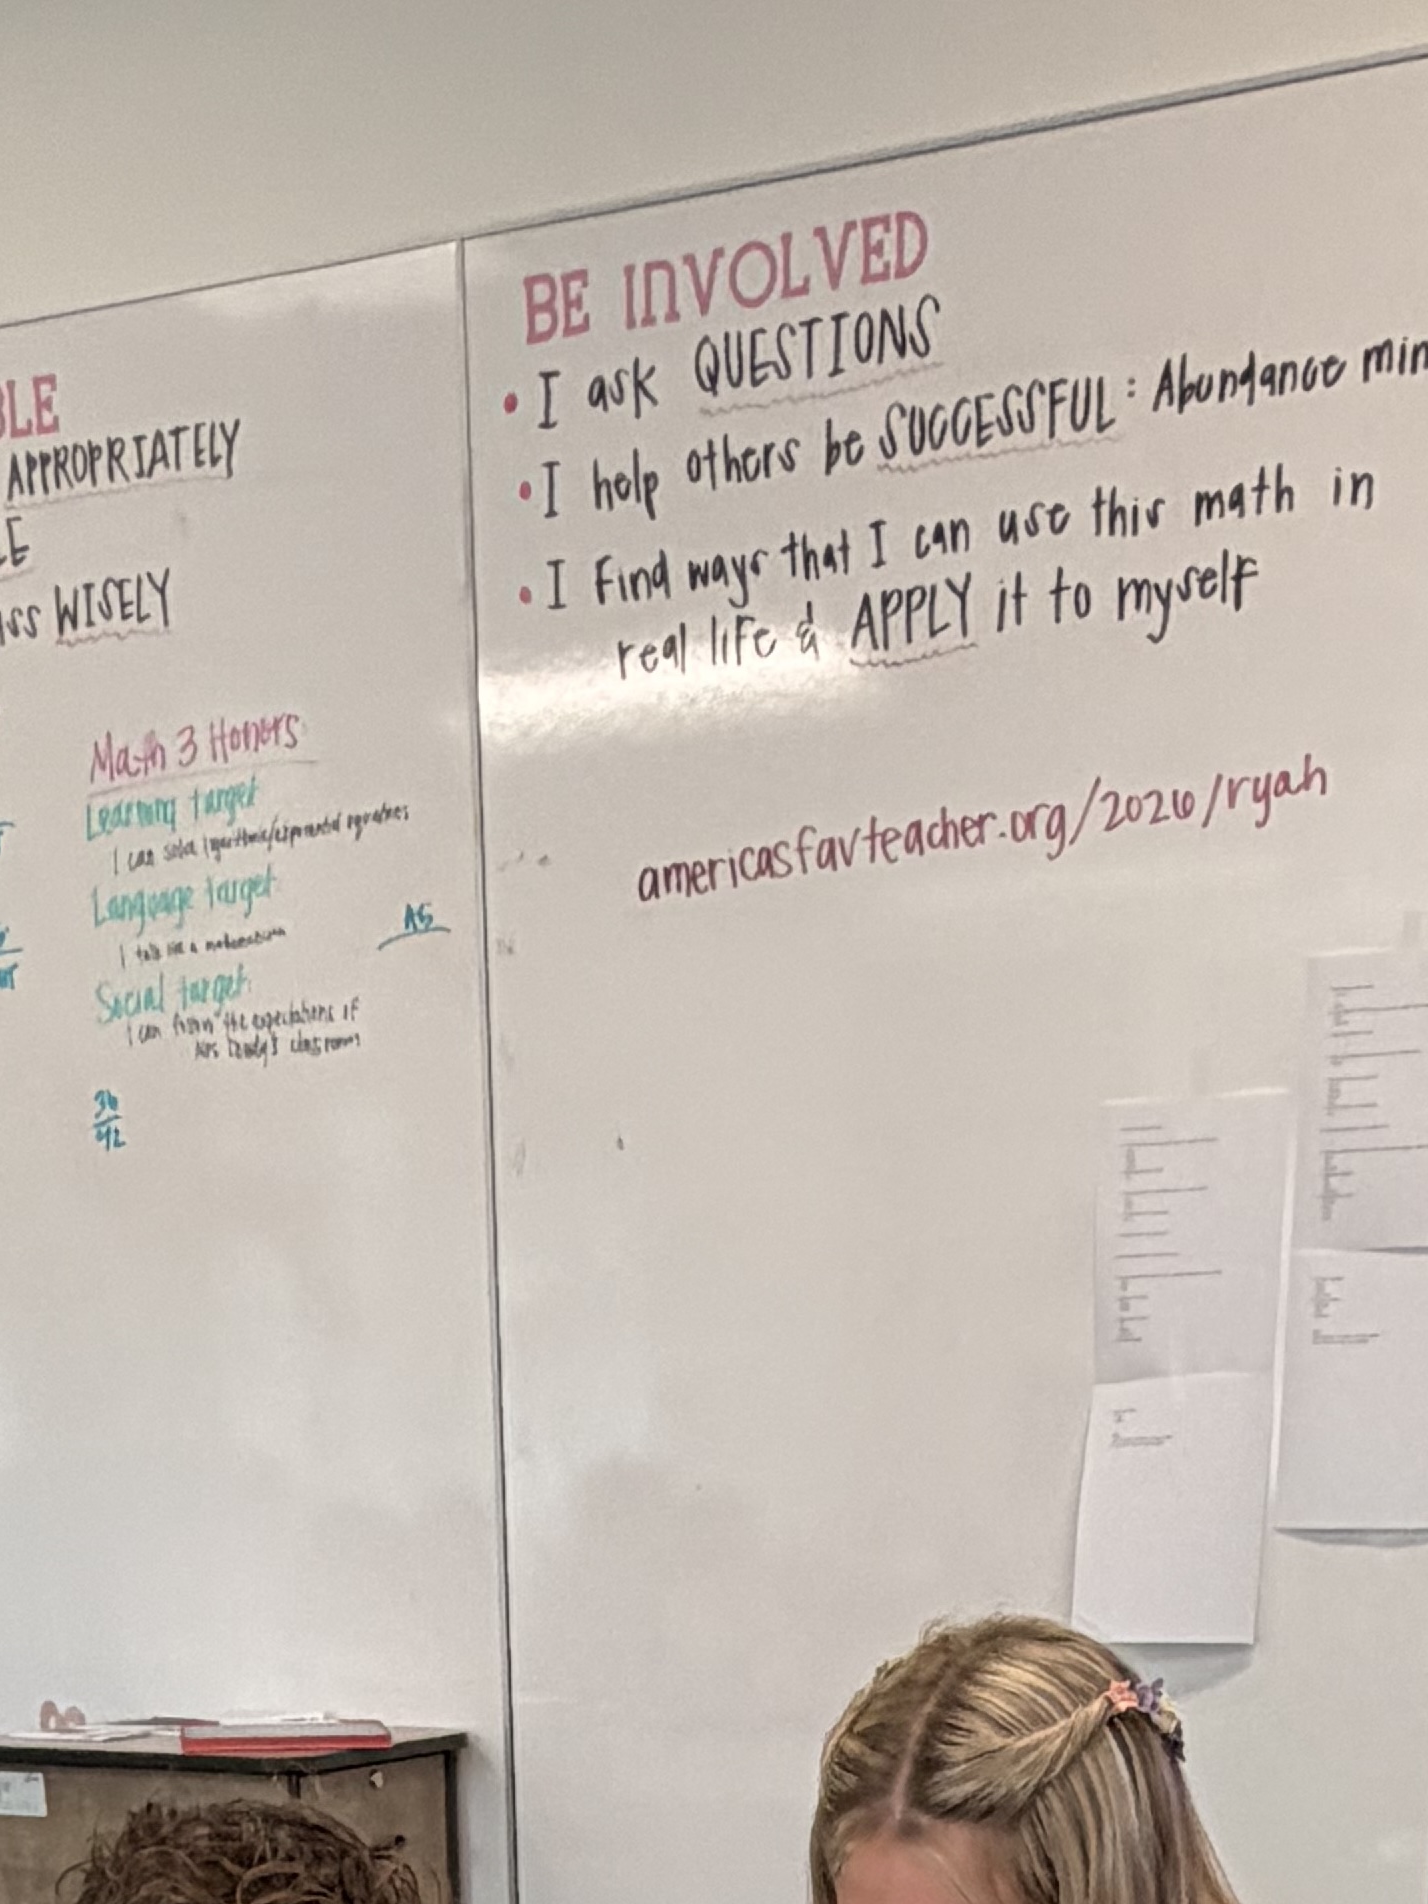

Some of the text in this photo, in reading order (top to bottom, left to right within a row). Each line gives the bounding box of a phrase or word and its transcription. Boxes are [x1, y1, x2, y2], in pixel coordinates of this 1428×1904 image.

[523, 269, 590, 345] BE
[538, 293, 941, 429] I ask QUESTIONS
[7, 420, 240, 499] APPROPRIATELY
[542, 461, 561, 518] I
[593, 449, 659, 520] help
[687, 434, 800, 490] others
[825, 419, 864, 475] be
[1153, 351, 1347, 413] Abundance
[547, 560, 567, 609] I
[688, 549, 769, 608] ways
[780, 529, 850, 581] that
[869, 520, 887, 569] I
[915, 518, 970, 560] can
[999, 502, 1070, 545] use
[1093, 486, 1165, 537] this
[1194, 464, 1295, 527] math
[1333, 467, 1374, 510] in
[56, 569, 171, 632] WISELY
[617, 624, 687, 680] real
[852, 573, 974, 651] APPLY
[996, 572, 1027, 632] it
[1049, 567, 1091, 623] to
[90, 713, 299, 784] Math 3 Honors
[637, 753, 1328, 902] americasfavteacher.org/2026/ryah
[95, 971, 164, 1025] Social
